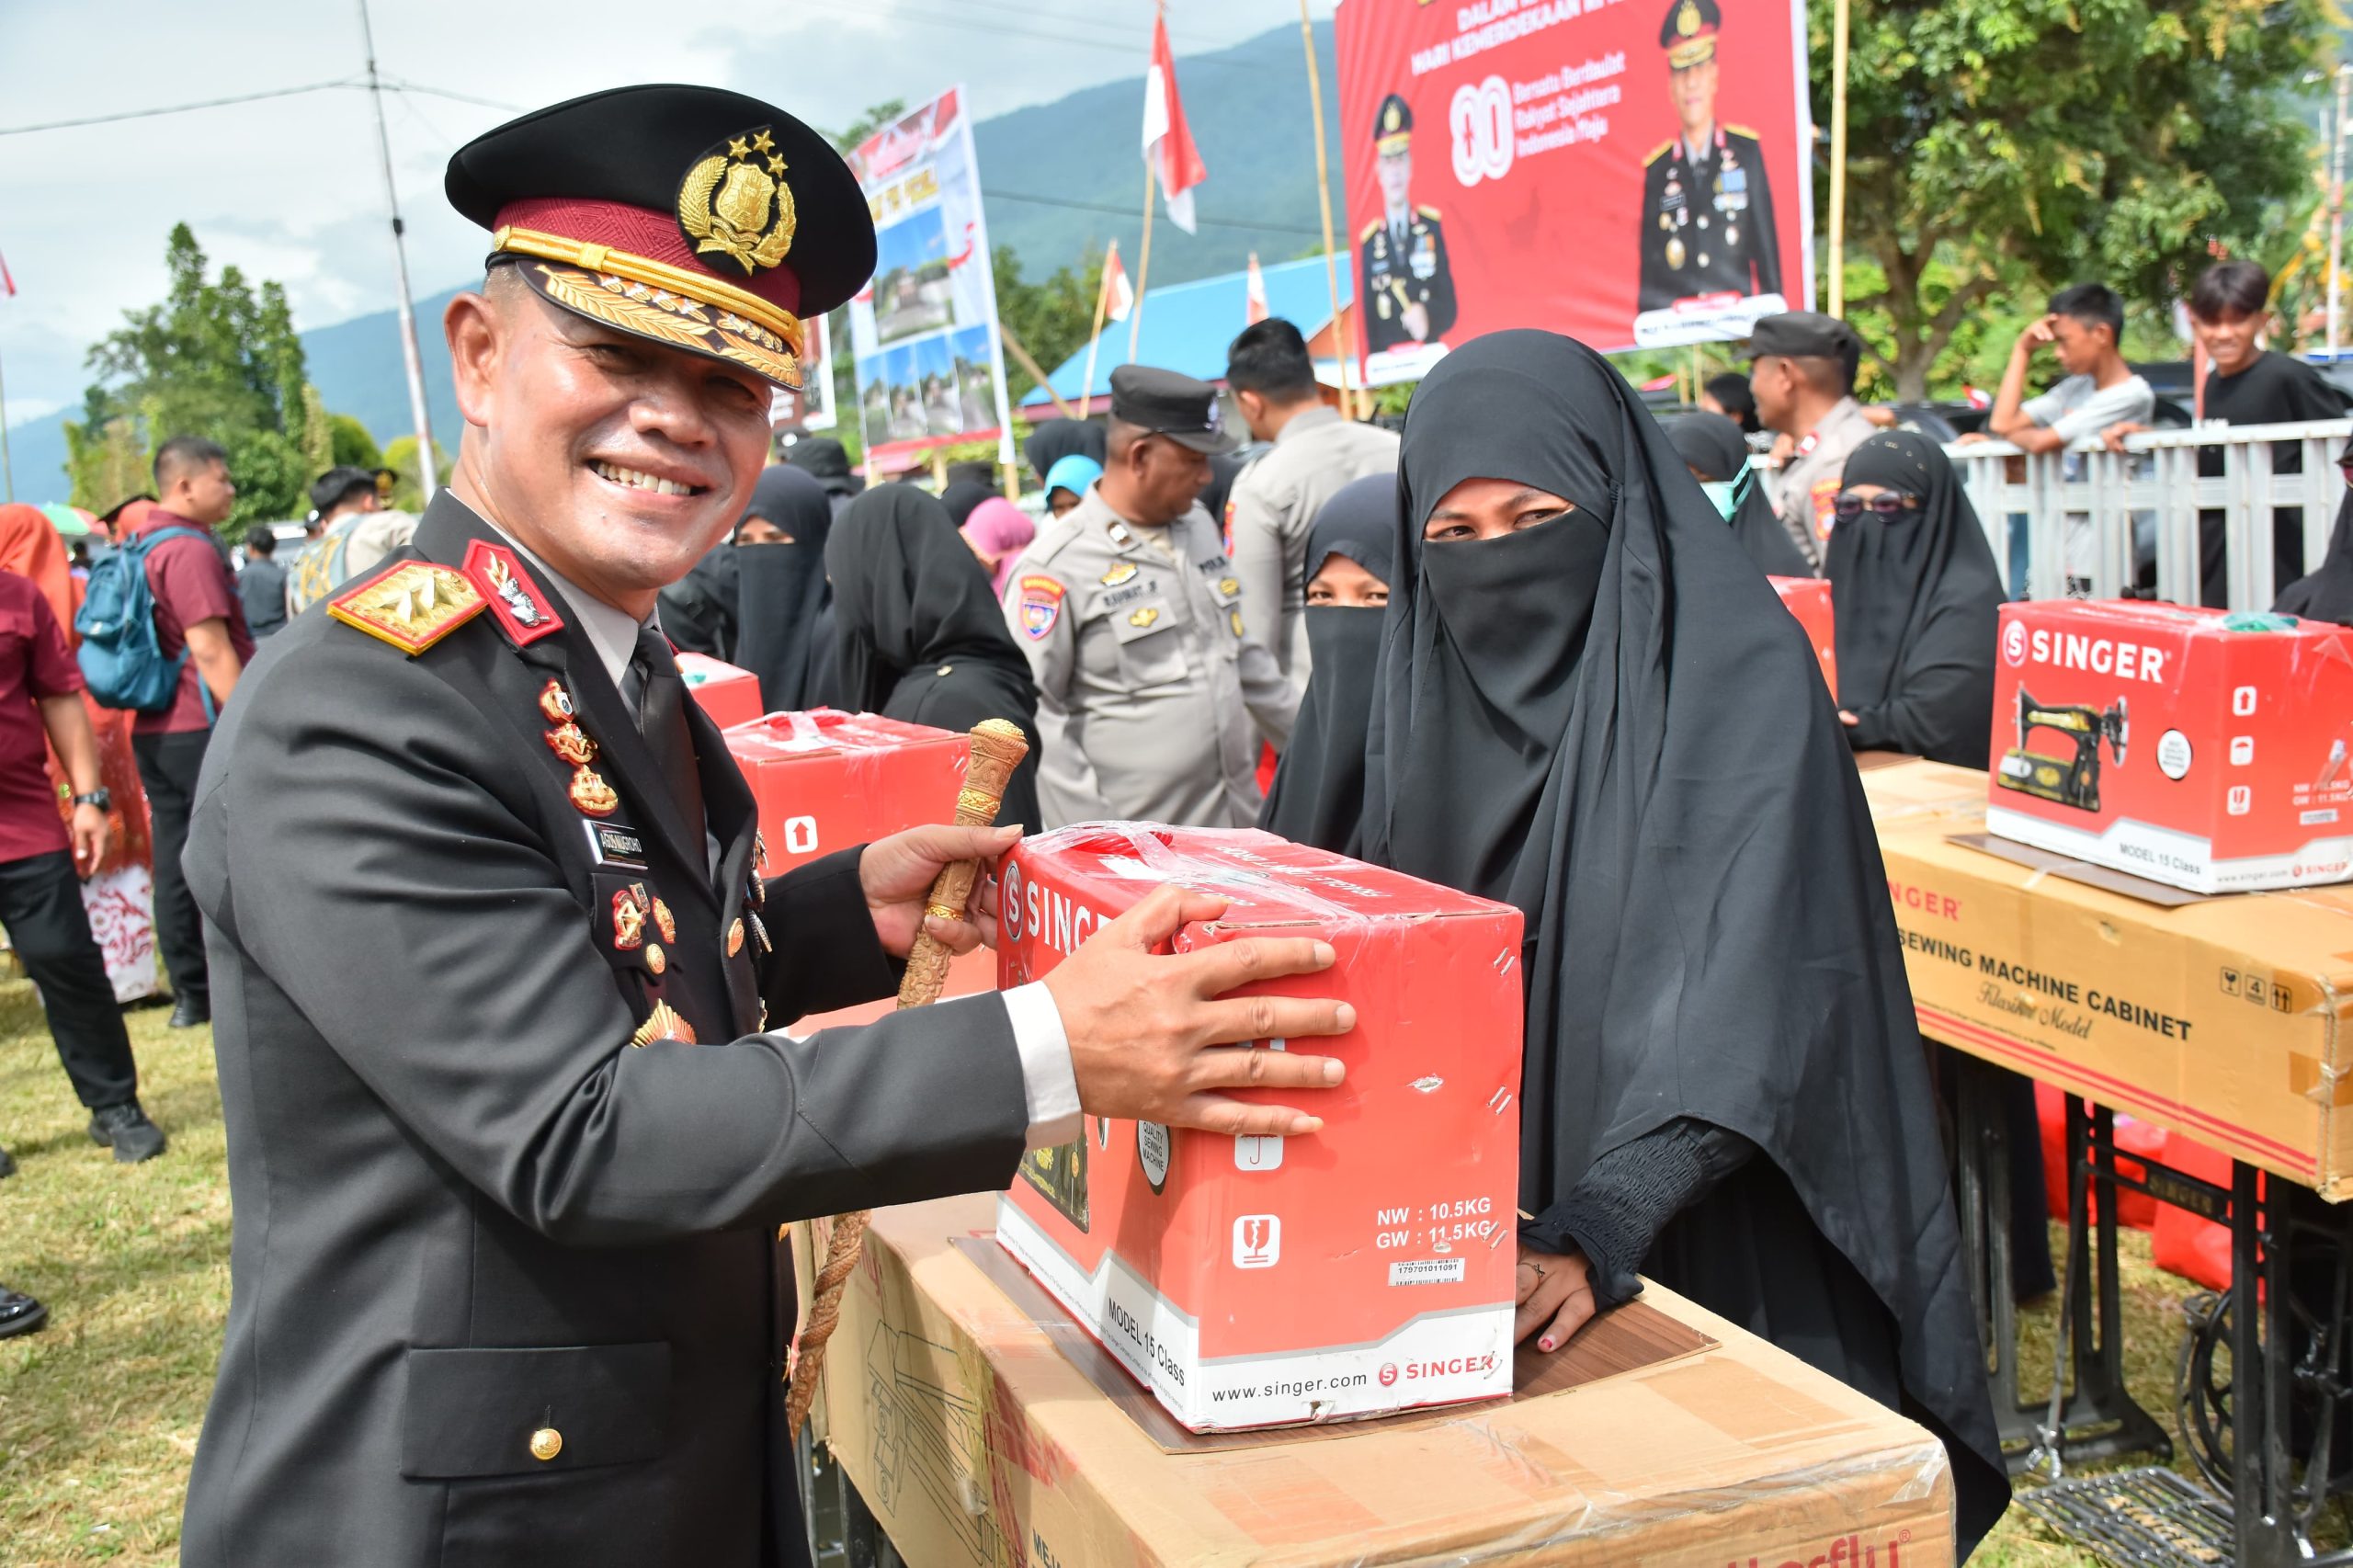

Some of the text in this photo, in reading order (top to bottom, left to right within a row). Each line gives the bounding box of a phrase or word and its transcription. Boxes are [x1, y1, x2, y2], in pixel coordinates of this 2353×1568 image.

[2032, 630, 2163, 683] SINGER
[2120, 842, 2154, 862] MODEL
[2173, 857, 2201, 874] Class
[1027, 881, 1113, 957] SING
[1886, 881, 1960, 922] NGER
[1898, 927, 1973, 967] SEWING
[1979, 954, 2080, 1005] MACHINE
[2086, 990, 2192, 1042] CABINET
[1376, 1230, 1410, 1250] GW
[1428, 1220, 1492, 1243] 11.5KG
[1378, 1207, 1410, 1226] NW
[1429, 1197, 1492, 1221] 10.5KG
[1108, 1296, 1185, 1387] MODEL 15 Class
[1211, 1372, 1368, 1402] www.singer.com
[1406, 1354, 1495, 1380] SINGER
